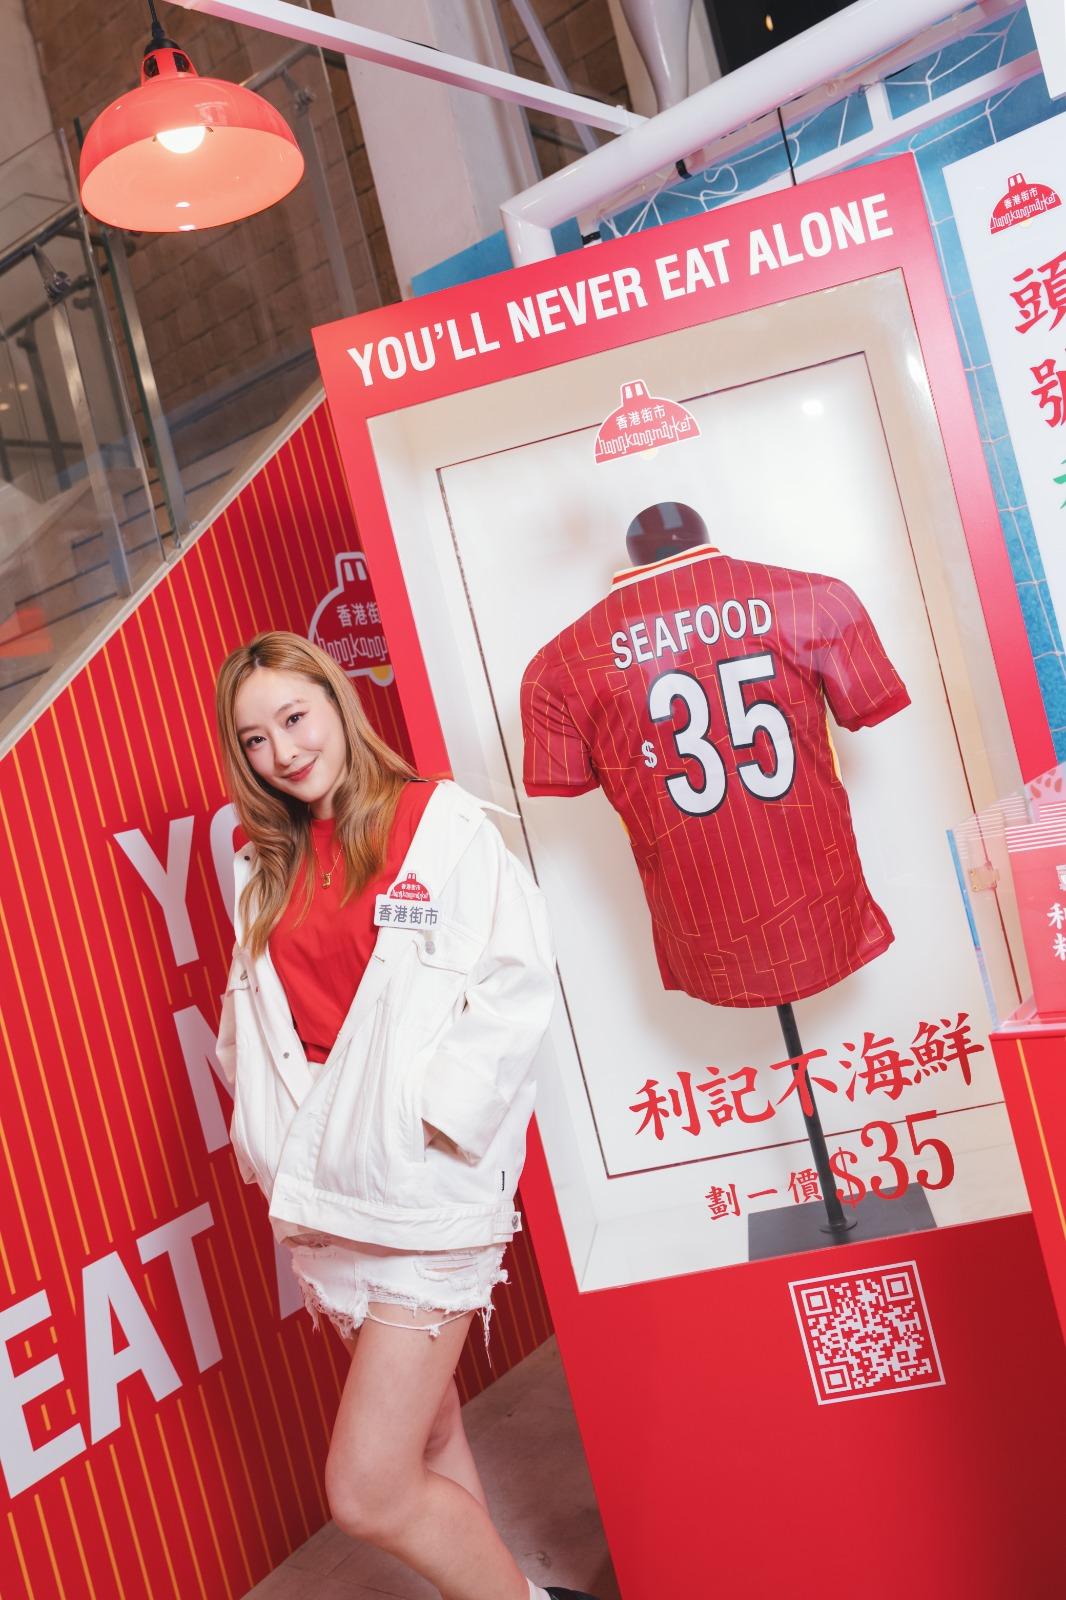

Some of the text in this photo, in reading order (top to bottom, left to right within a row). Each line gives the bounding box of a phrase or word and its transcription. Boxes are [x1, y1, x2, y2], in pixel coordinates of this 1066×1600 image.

[346, 193, 894, 387] YOU'LL NEVER EAT ALONE
[616, 405, 665, 430] 香港街市
[611, 598, 772, 669] SEAFOOD
[379, 904, 438, 925] 香港街市
[629, 1012, 984, 1141] 利記不海鮮
[705, 1110, 955, 1221] 劃一價 $35
[0, 1202, 222, 1499] EAT
